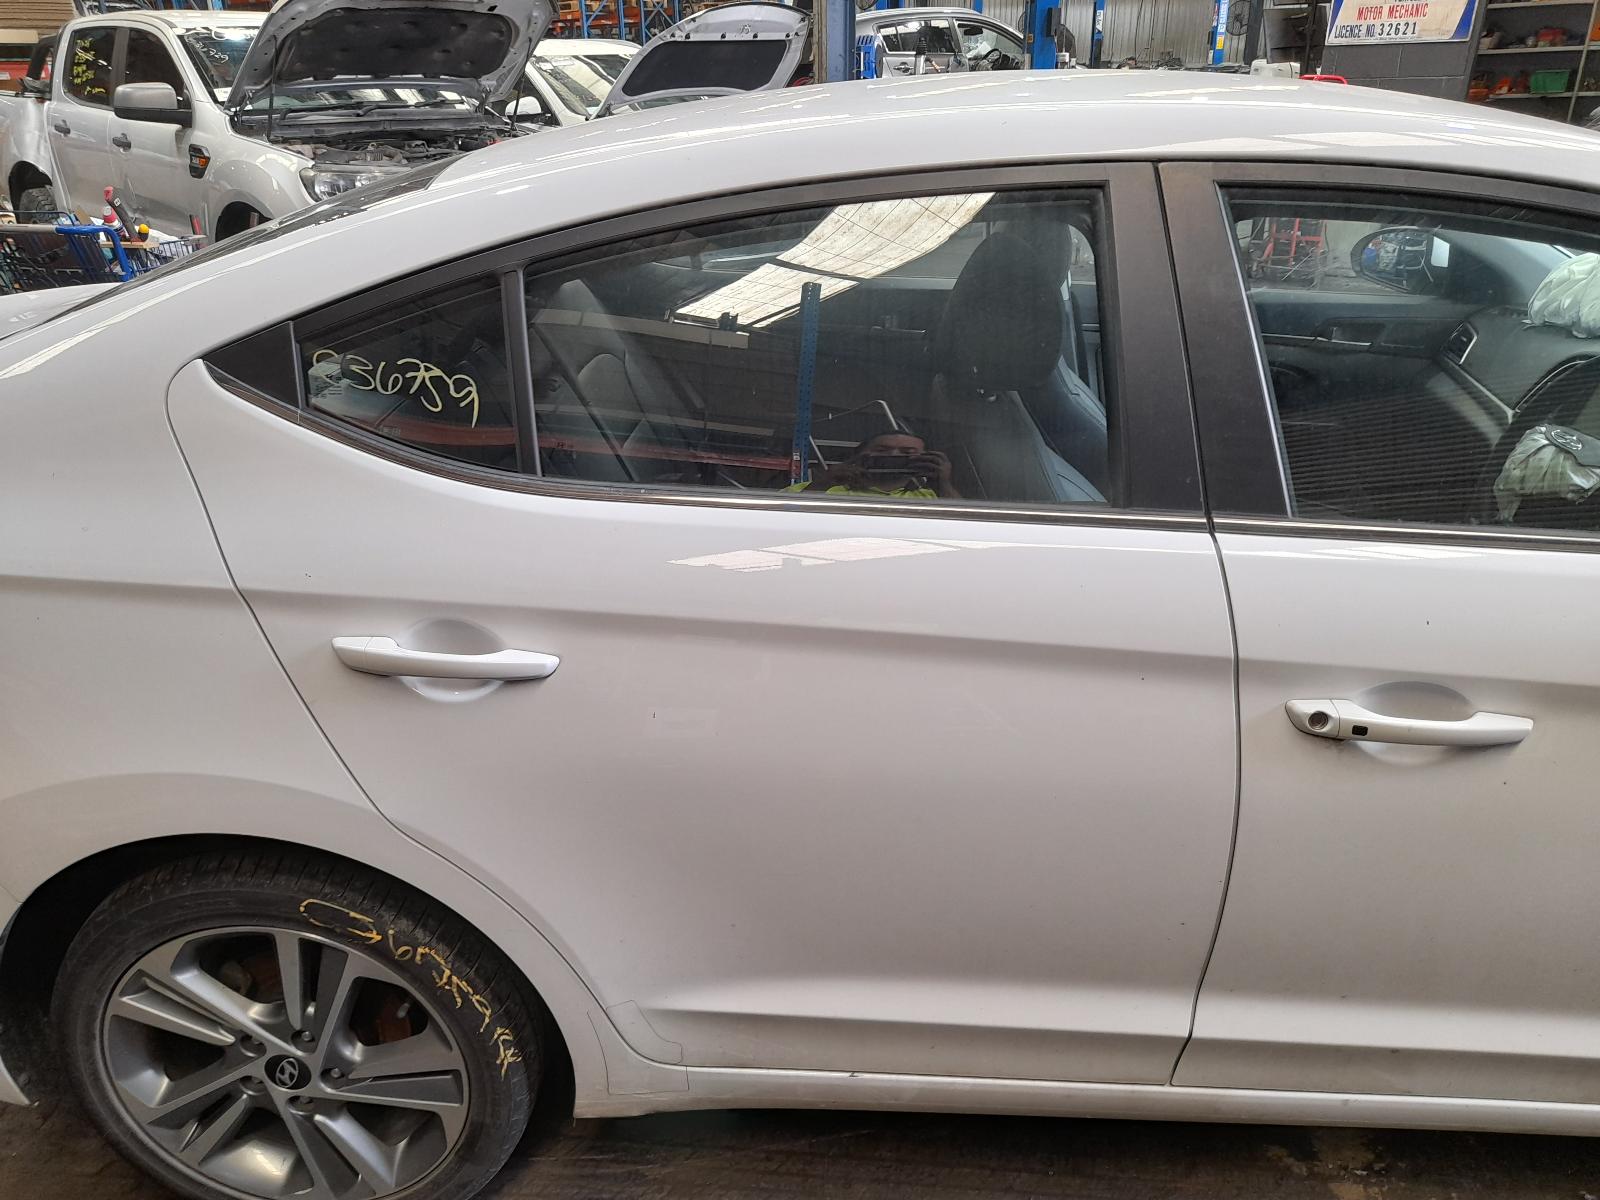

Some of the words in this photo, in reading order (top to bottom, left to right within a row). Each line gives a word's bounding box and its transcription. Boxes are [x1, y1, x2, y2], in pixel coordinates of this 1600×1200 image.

[1357, 6, 1383, 21] MOTOR
[1387, 3, 1429, 18] MECHANIC
[1334, 24, 1362, 39] LICENCE
[1378, 22, 1417, 36] 32621
